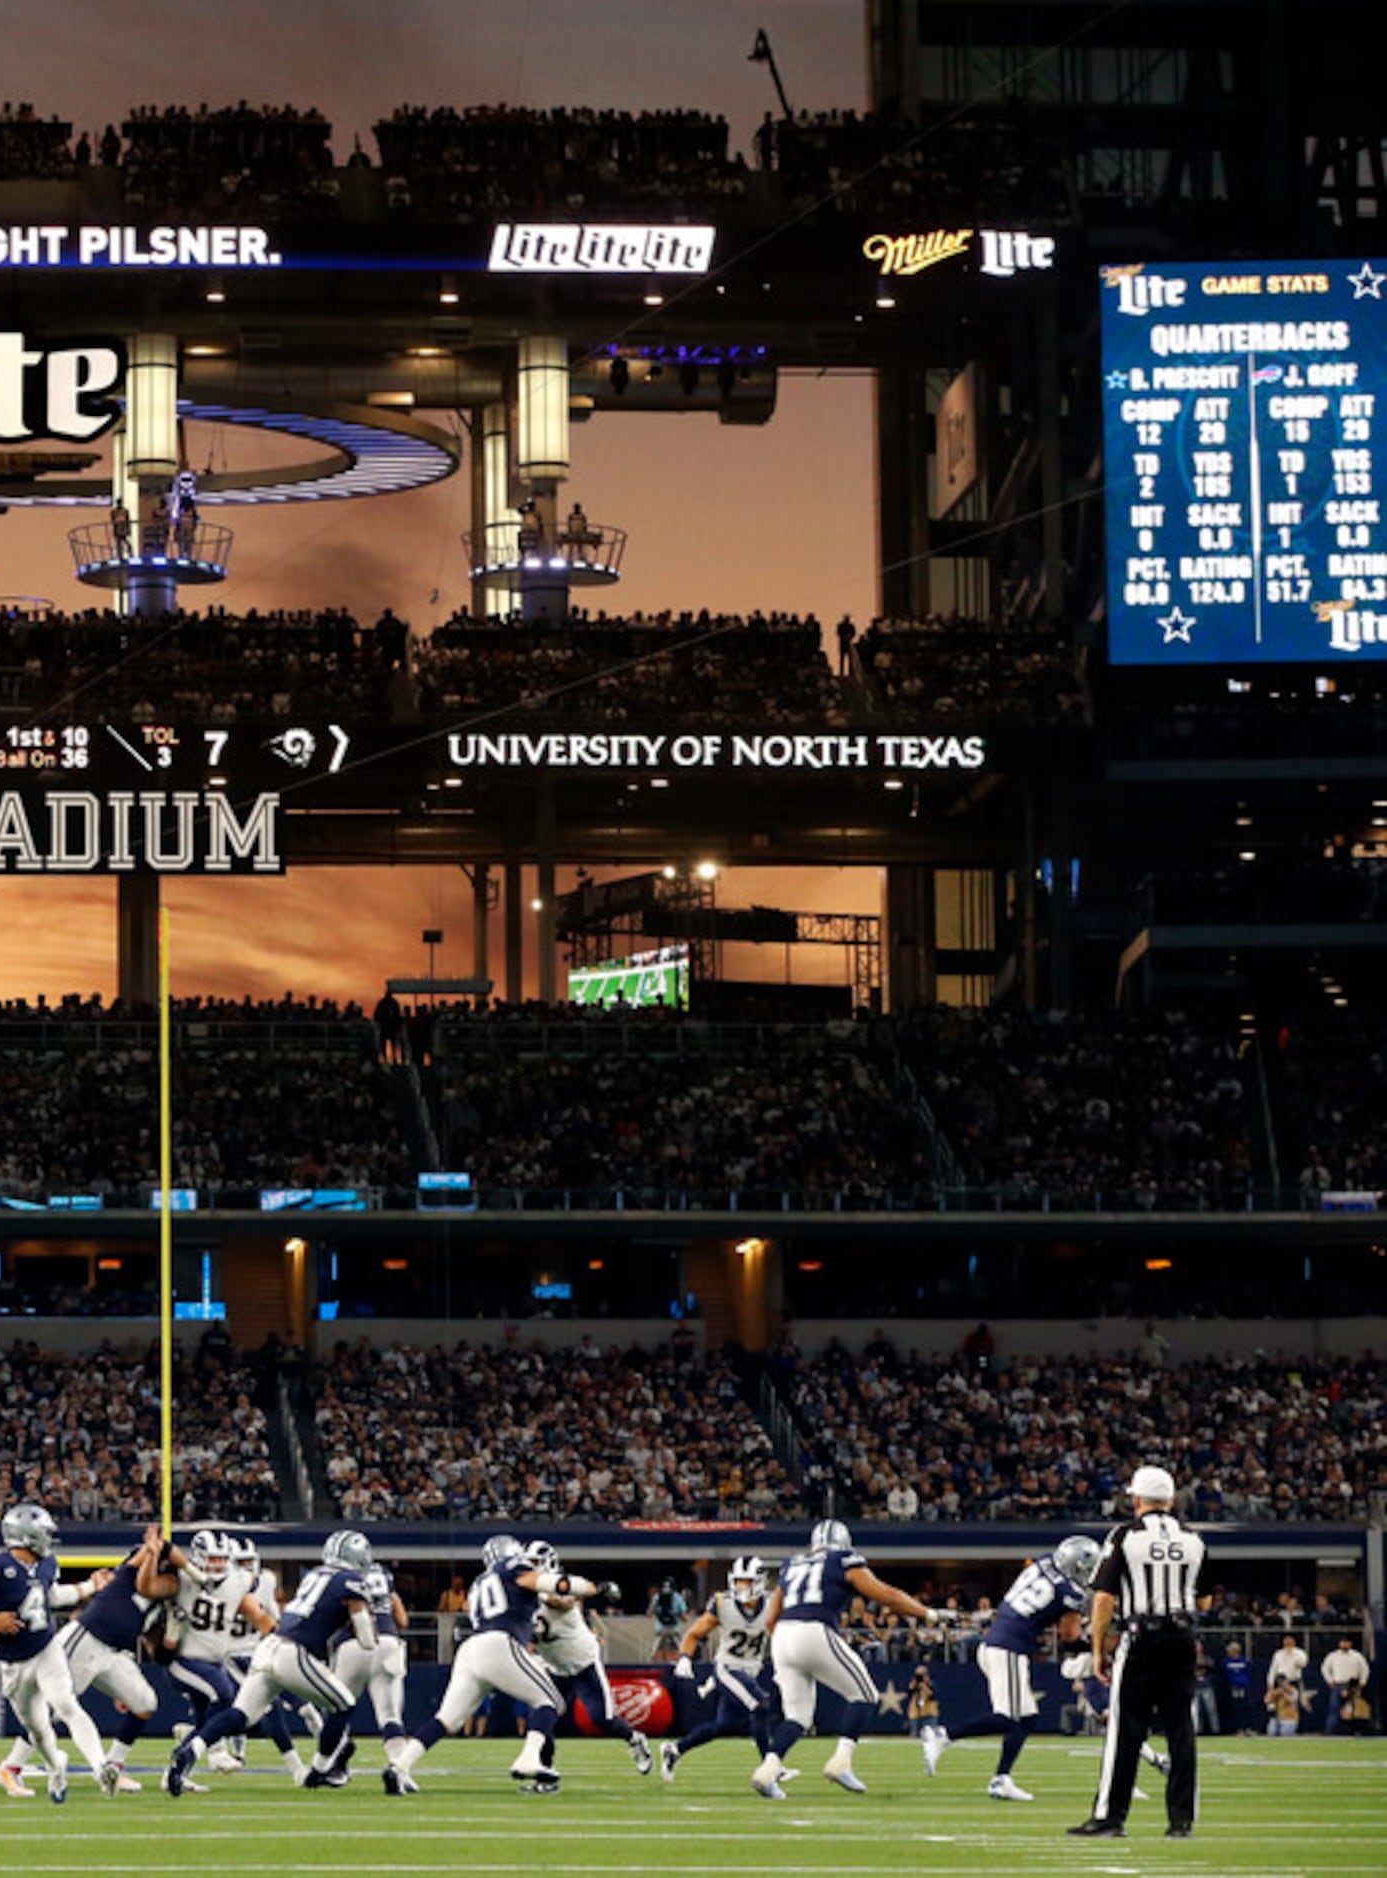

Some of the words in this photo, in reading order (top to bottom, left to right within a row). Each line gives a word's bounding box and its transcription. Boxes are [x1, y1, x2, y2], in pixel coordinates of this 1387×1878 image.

[80, 225, 282, 264] PILSNER.
[863, 229, 974, 275] Miller
[979, 229, 1055, 277] Lite
[1116, 275, 1187, 316] Lite
[1201, 276, 1262, 295] GAME
[1266, 274, 1329, 293] STATS
[1150, 321, 1349, 356] QUARTERBACKS
[1152, 365, 1239, 390] PRESCOTT
[1283, 364, 1304, 387] J.
[1307, 363, 1358, 386] GOFF
[1121, 397, 1181, 423] COMP
[1194, 397, 1230, 421] ATT
[1268, 395, 1329, 419] COMP
[1340, 394, 1375, 418] ATT
[1136, 422, 1162, 446] 12
[1283, 420, 1310, 443] 15
[1132, 453, 1160, 476] TD
[1192, 451, 1233, 474] YDS
[1278, 451, 1305, 473] TD
[1331, 449, 1372, 472] YDS
[1139, 476, 1155, 498] 2
[1285, 474, 1297, 496] 1
[1333, 473, 1372, 495] 153
[1130, 505, 1165, 527] INT
[1187, 503, 1242, 526] SACK
[1268, 502, 1303, 525] INT
[1325, 501, 1380, 525] SACK
[1278, 527, 1291, 548] 1
[1127, 557, 1172, 581] PCT.
[1180, 556, 1252, 580] RATING
[1266, 555, 1310, 578] PCT.
[1328, 553, 1387, 577] RATIN
[1266, 579, 1312, 603] 51.7
[6, 727, 42, 747] 1st
[62, 727, 88, 747] 10
[141, 727, 179, 746] TOL
[30, 750, 55, 768] On
[62, 748, 88, 768] 36
[157, 747, 172, 768] 3
[203, 732, 228, 767] 7
[448, 734, 665, 766] UNIVERSITY
[671, 735, 721, 766] OF
[732, 735, 867, 769] NORTH
[877, 736, 984, 768] TEXAS
[1149, 1542, 1184, 1561] 66
[783, 1562, 824, 1608] 71
[19, 1583, 48, 1632] 4
[191, 1599, 225, 1631] 91
[725, 1629, 767, 1658] 24
